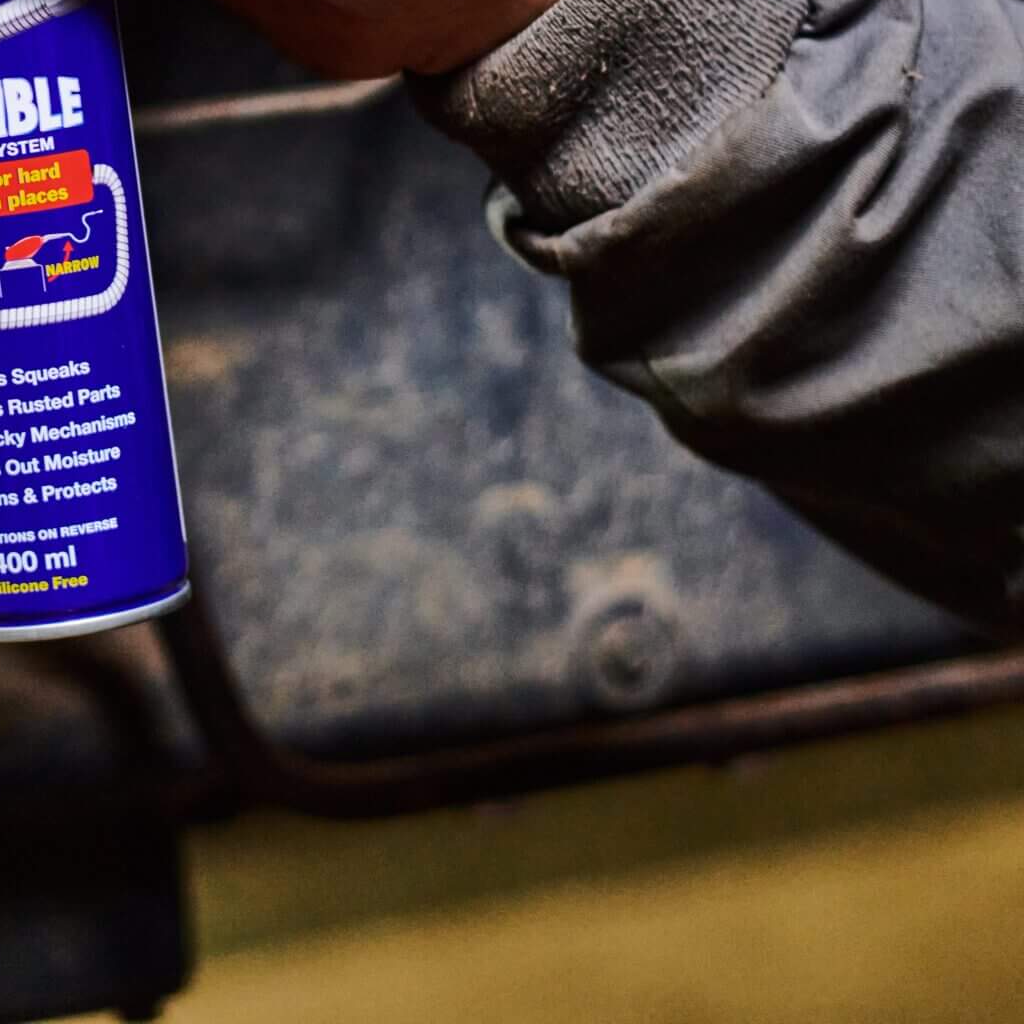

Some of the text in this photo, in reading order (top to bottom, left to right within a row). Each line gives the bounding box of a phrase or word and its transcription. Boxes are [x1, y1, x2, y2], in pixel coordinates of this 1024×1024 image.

[18, 162, 61, 184] hard
[8, 185, 69, 211] places
[45, 256, 99, 277] NARROW
[11, 360, 91, 386] Squeaks
[8, 391, 75, 416] Rusted
[78, 384, 121, 405] Parts
[30, 410, 136, 444] Mechanisms
[5, 458, 41, 477] Out
[44, 444, 121, 472] Moisture
[23, 487, 39, 504] &
[41, 475, 118, 502] Protects
[37, 528, 58, 541] ON
[60, 517, 118, 538] REVERSE
[45, 545, 77, 569] ml
[52, 574, 89, 590] Free
